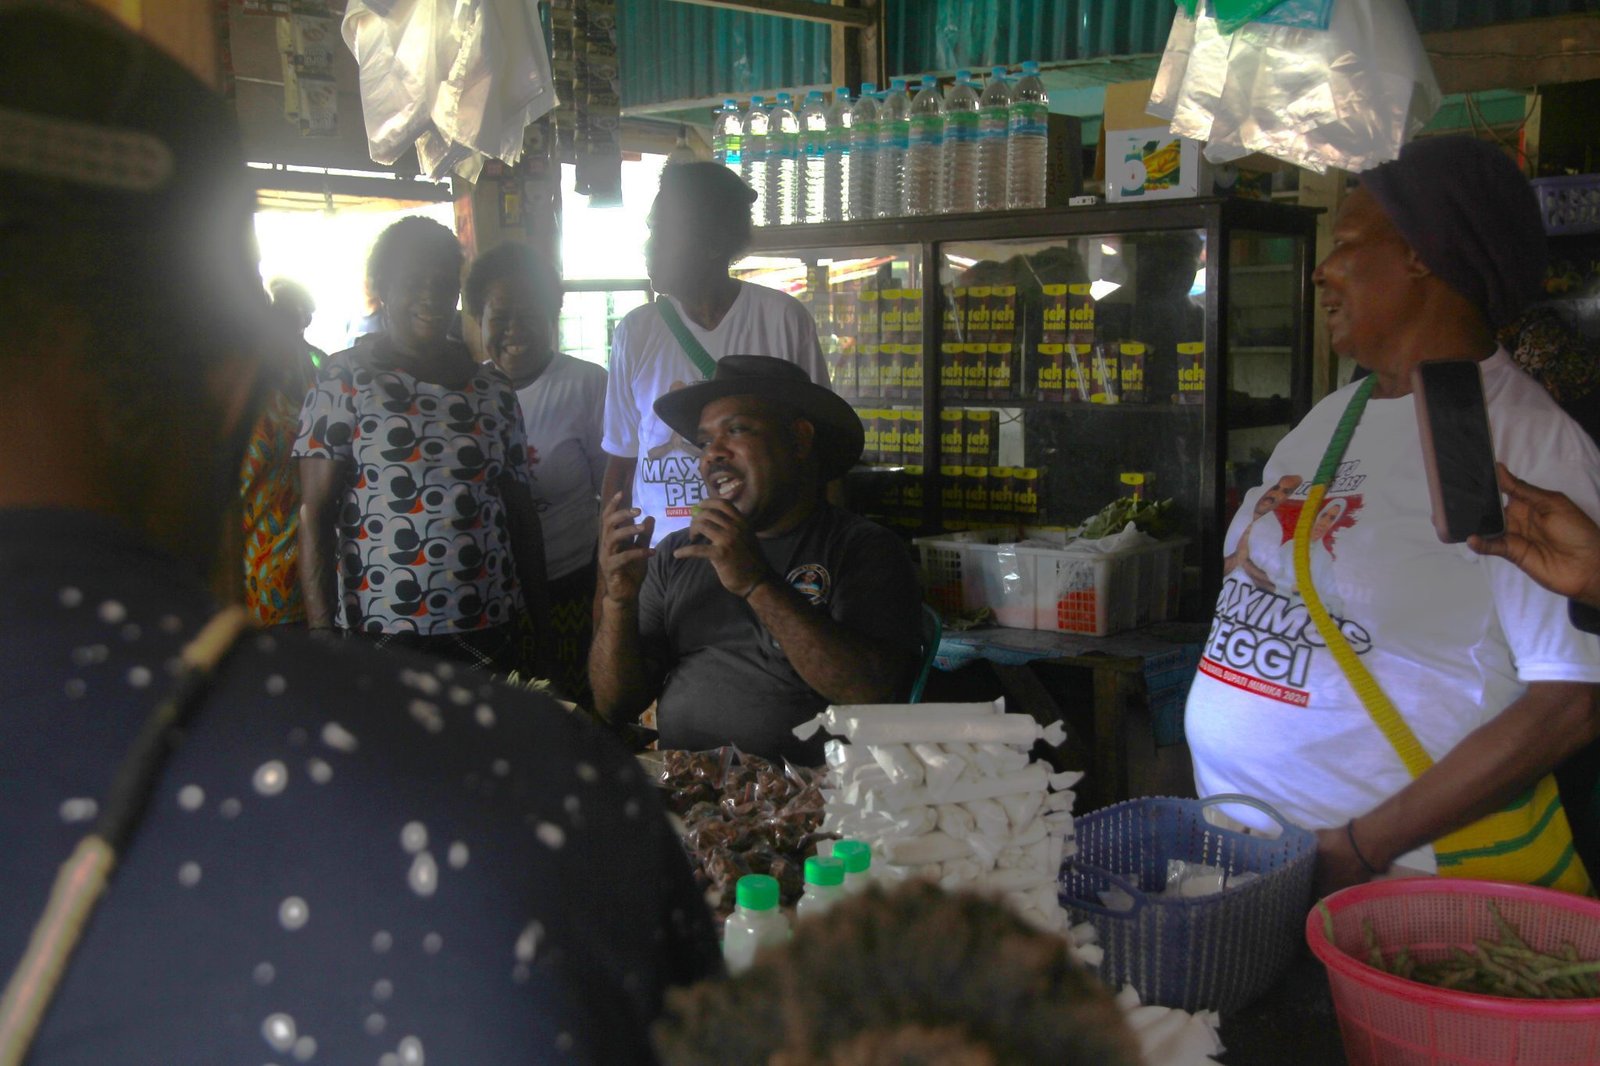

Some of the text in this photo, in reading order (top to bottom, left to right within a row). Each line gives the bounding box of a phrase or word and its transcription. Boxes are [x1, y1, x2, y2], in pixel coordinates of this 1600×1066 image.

[968, 304, 990, 321] teh
[991, 304, 1014, 321] teh
[1043, 304, 1065, 320] teh
[1069, 304, 1094, 321] teh
[941, 360, 962, 377] teh
[964, 360, 986, 378] teh
[1038, 362, 1062, 379] teh
[1121, 363, 1143, 380] teh
[1178, 362, 1205, 380] teh
[967, 428, 989, 445] teh
[1247, 680, 1281, 697] MIMIKA
[1283, 691, 1307, 704] 2024
